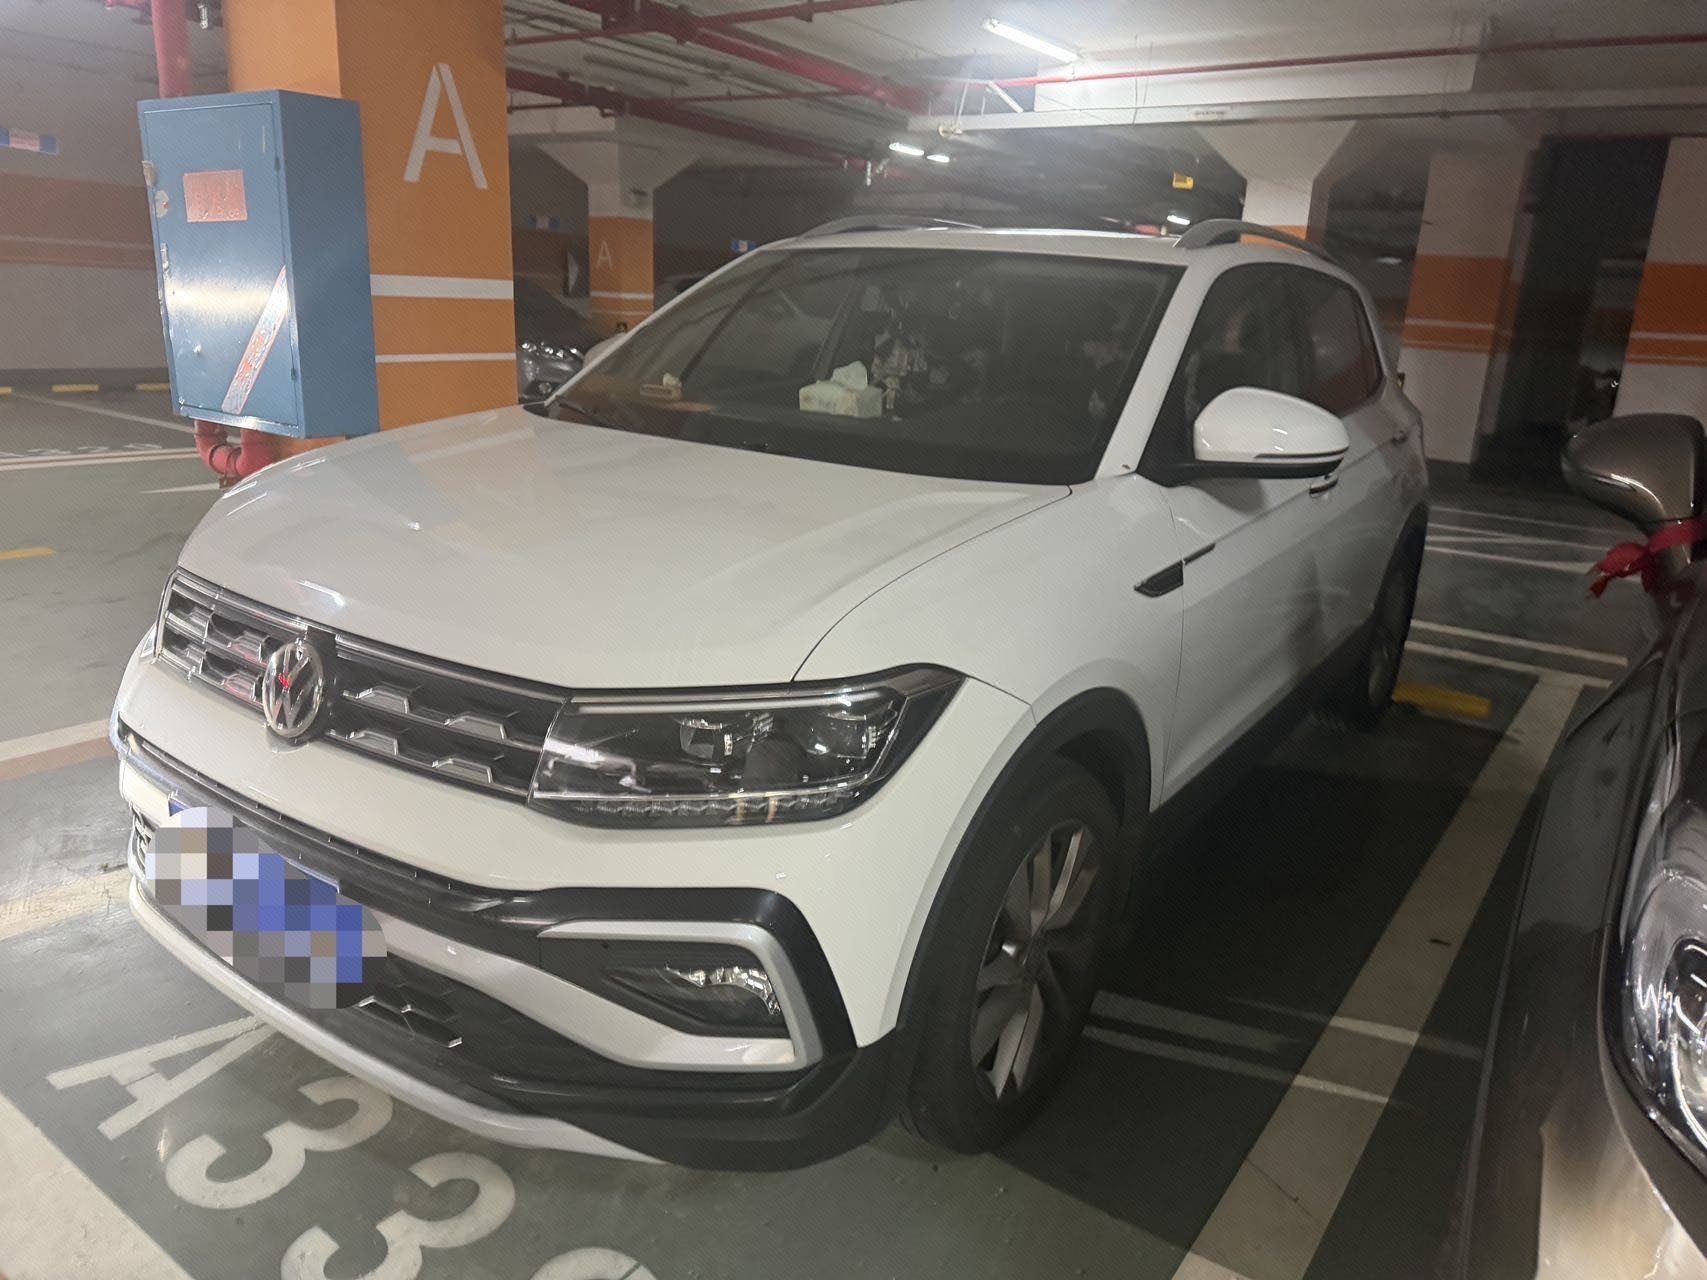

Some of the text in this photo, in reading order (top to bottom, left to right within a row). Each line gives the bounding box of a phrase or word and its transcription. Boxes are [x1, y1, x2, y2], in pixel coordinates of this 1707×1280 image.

[403, 62, 489, 190] A
[597, 239, 613, 270] A
[46, 1015, 657, 1280] A33
